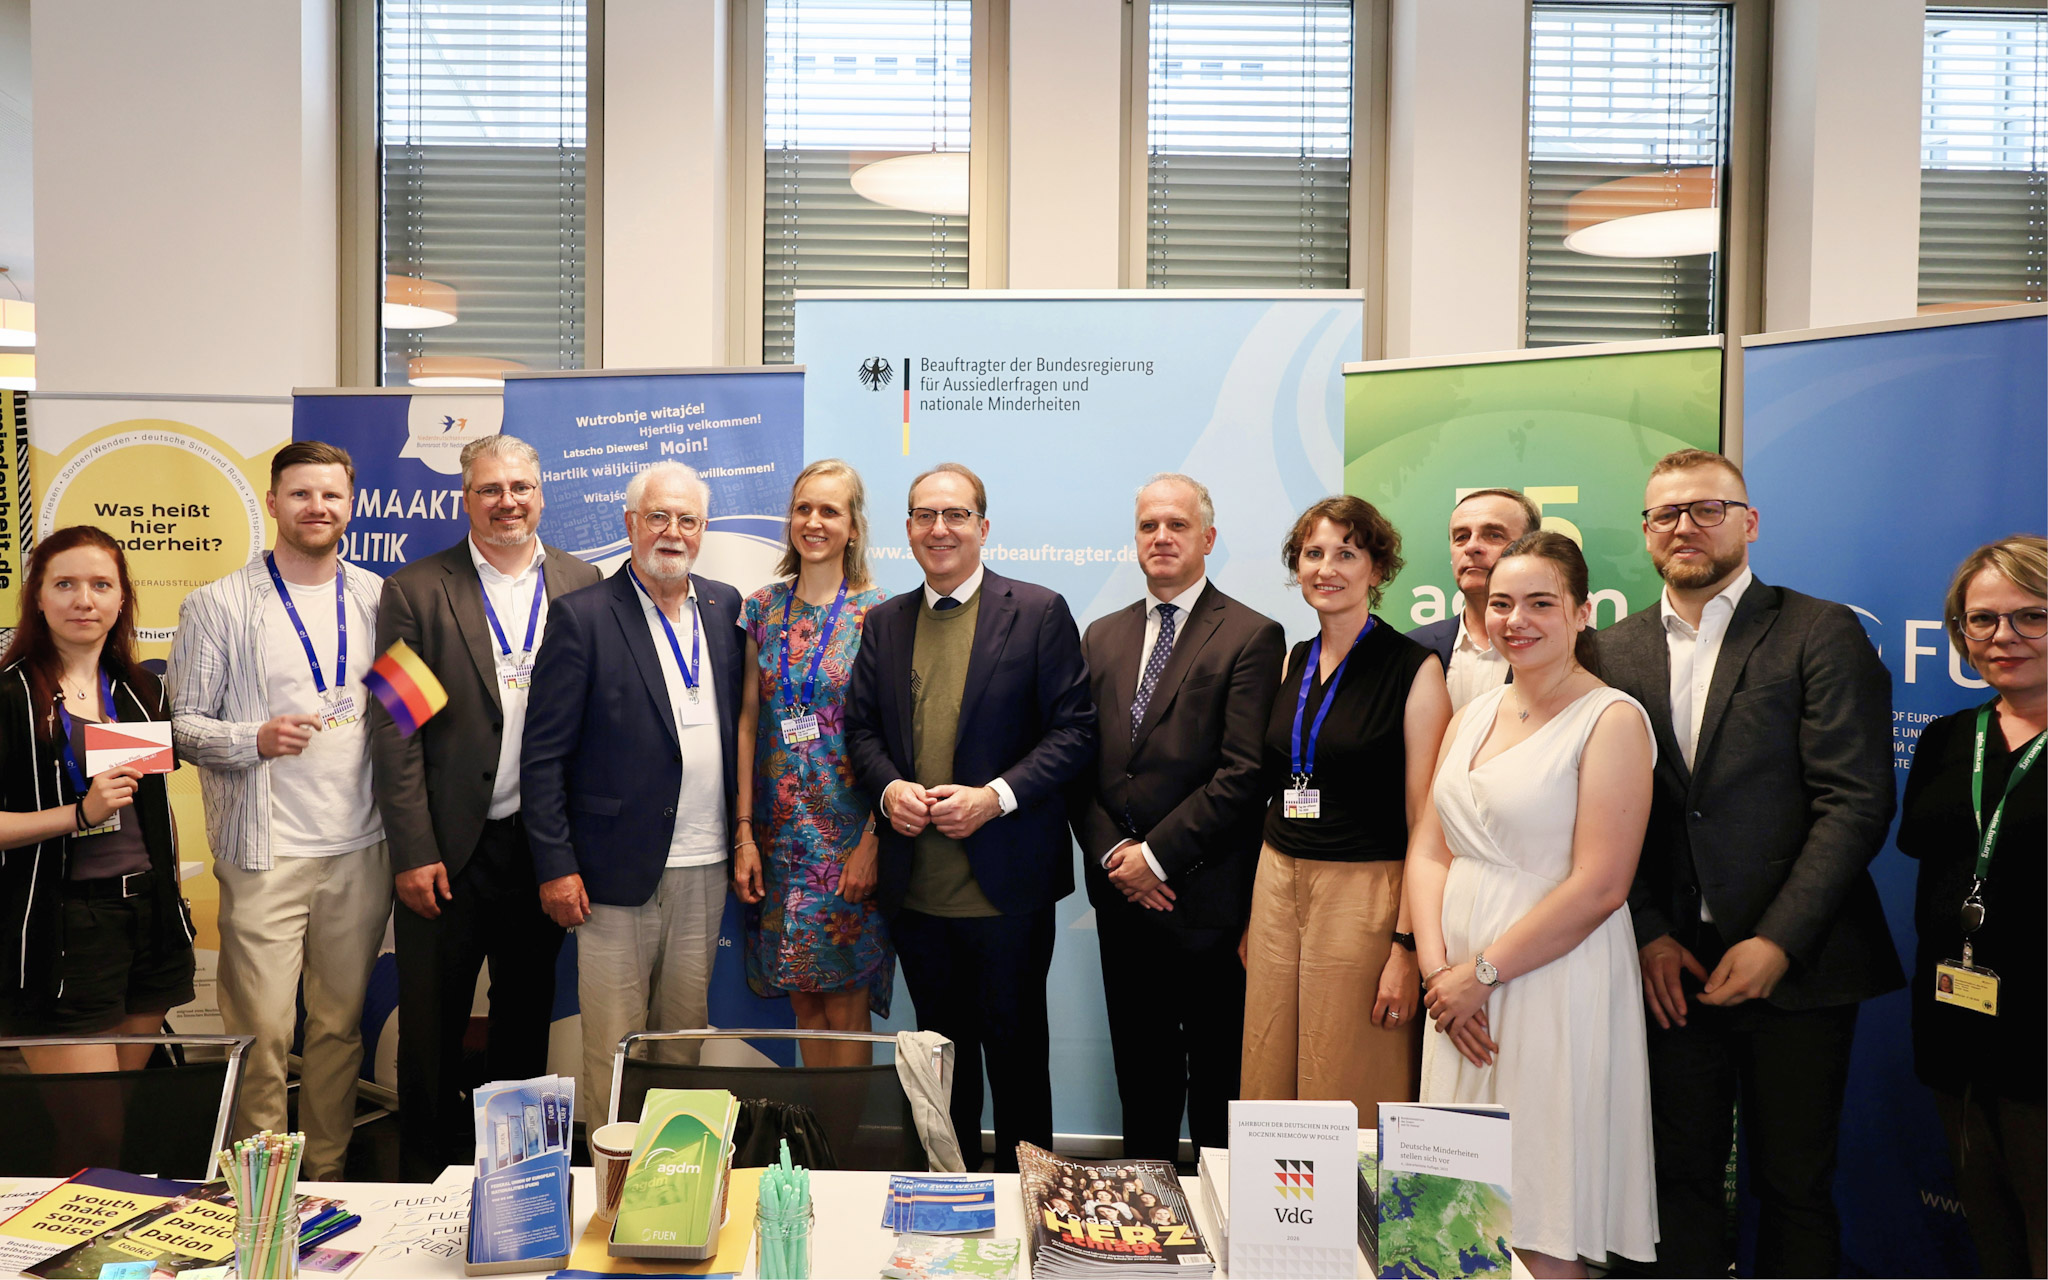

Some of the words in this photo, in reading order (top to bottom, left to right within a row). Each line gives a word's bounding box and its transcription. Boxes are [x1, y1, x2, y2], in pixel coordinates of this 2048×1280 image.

[921, 357, 1006, 375] Beauftragter
[1010, 357, 1032, 372] der
[1037, 357, 1154, 375] Bundesregierung
[920, 377, 940, 391] für
[943, 377, 1058, 394] Aussiedlerfragen
[1063, 377, 1089, 391] und
[920, 396, 983, 411] nationale
[988, 396, 1080, 411] Minderheiten
[576, 410, 647, 428] Wutrobnje
[650, 402, 705, 419] witajće!
[639, 423, 684, 438] Hjertlig
[687, 413, 762, 431] velkommen!
[563, 446, 603, 458] Latscho
[606, 441, 648, 454] Diewes!
[660, 437, 708, 455] Moin!
[62, 435, 131, 480] Sorben/Wenden
[141, 433, 186, 446] deutsche
[188, 441, 209, 456] Sinti
[210, 454, 228, 469] und
[226, 467, 247, 491] Roma
[543, 467, 588, 482] Hartlik
[699, 462, 775, 478] willkommen!
[43, 486, 61, 520] Friesen
[94, 503, 144, 517] Was
[152, 503, 210, 518] heißt
[355, 488, 464, 521] MAAKT
[130, 520, 177, 534] hier
[247, 498, 260, 560] Plattspreche
[116, 537, 222, 552] nderheit?
[337, 532, 408, 563] OLITIK
[1907, 712, 1944, 724] EURO
[1400, 1142, 1431, 1152] Deutsche
[1433, 1146, 1479, 1159] Minderheiten
[1400, 1153, 1422, 1161] stellen
[1424, 1154, 1437, 1163] sich
[657, 1162, 700, 1176] agdm
[59, 1204, 118, 1217] make
[69, 1194, 139, 1211] youth,
[394, 1196, 447, 1208] FUEN
[45, 1213, 106, 1226] some
[428, 1210, 471, 1221] FUE
[1044, 1202, 1081, 1221] Wo
[1086, 1216, 1122, 1227] das
[1274, 1207, 1314, 1224] VdG
[32, 1222, 93, 1236] noise
[432, 1225, 468, 1235] FUE
[653, 1231, 676, 1240] FUEN
[1044, 1209, 1196, 1246] HERZ
[141, 1228, 214, 1252] pation
[412, 1237, 460, 1258] FUEN
[118, 1242, 154, 1257] toolkit
